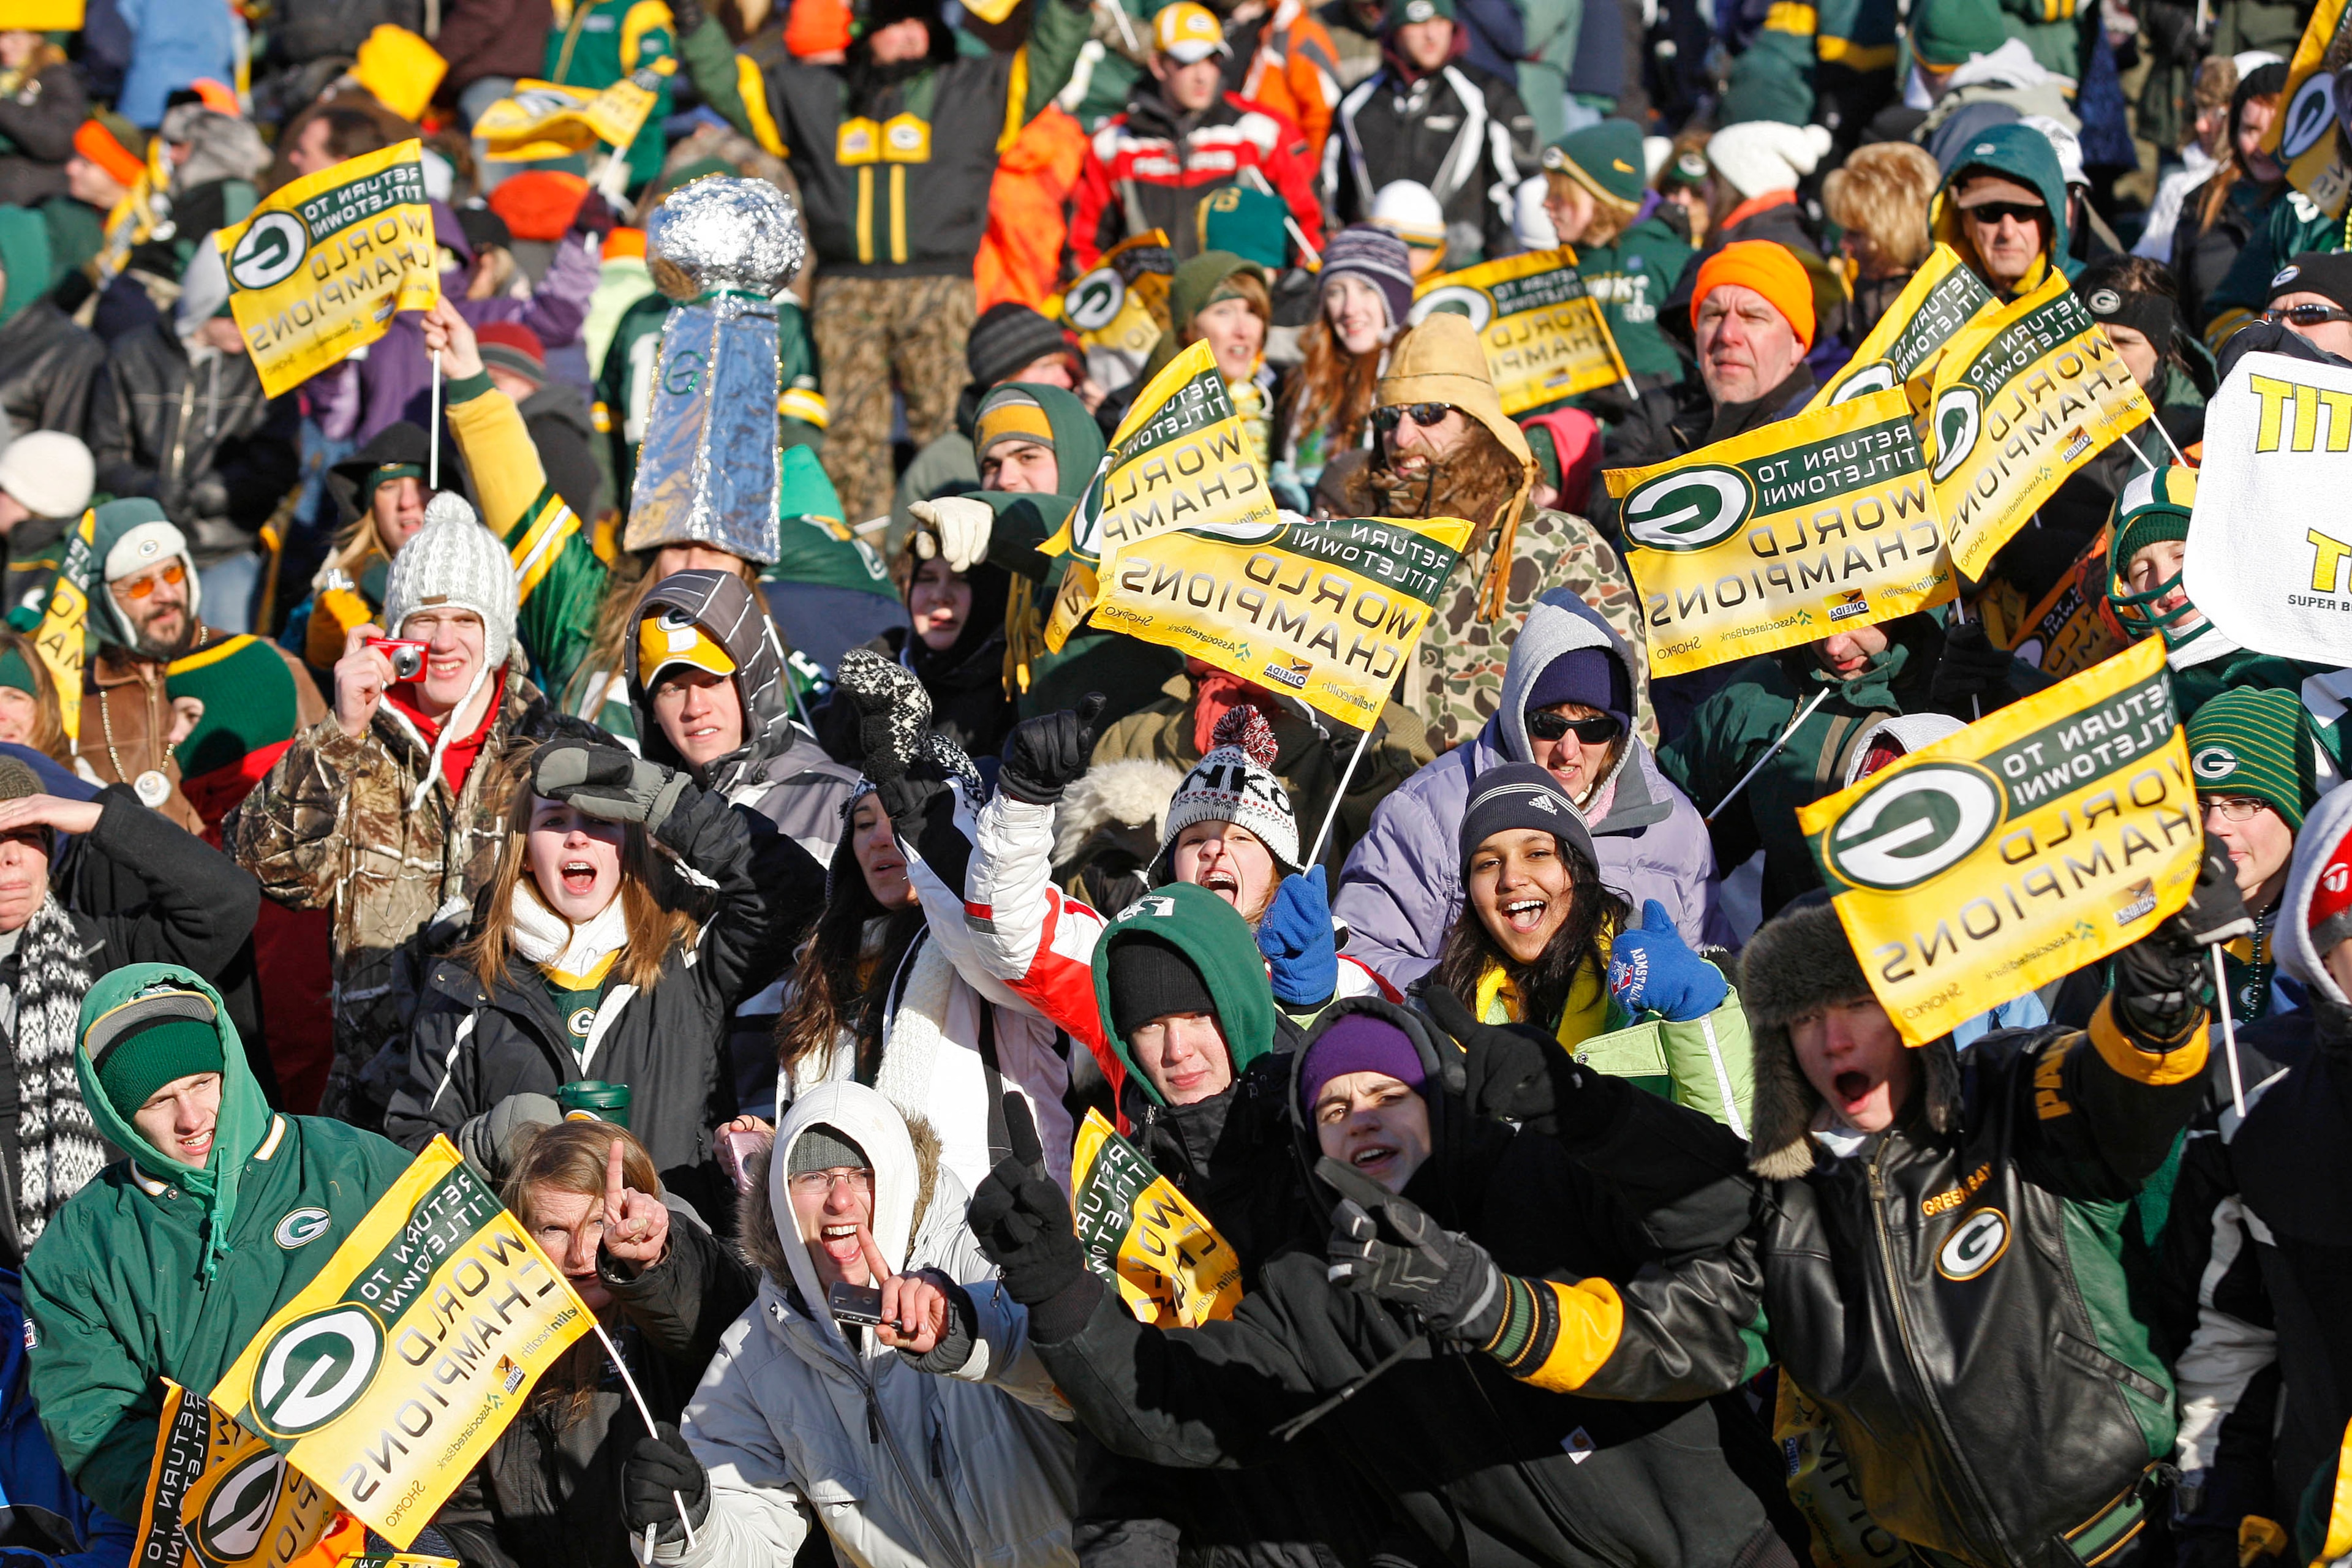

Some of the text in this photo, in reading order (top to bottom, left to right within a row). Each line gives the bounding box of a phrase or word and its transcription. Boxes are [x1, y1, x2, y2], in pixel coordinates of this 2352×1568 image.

[2288, 595, 2336, 609] SUPER
[1528, 801, 1558, 816] adidas
[1922, 1162, 1992, 1216] GREEN BAY
